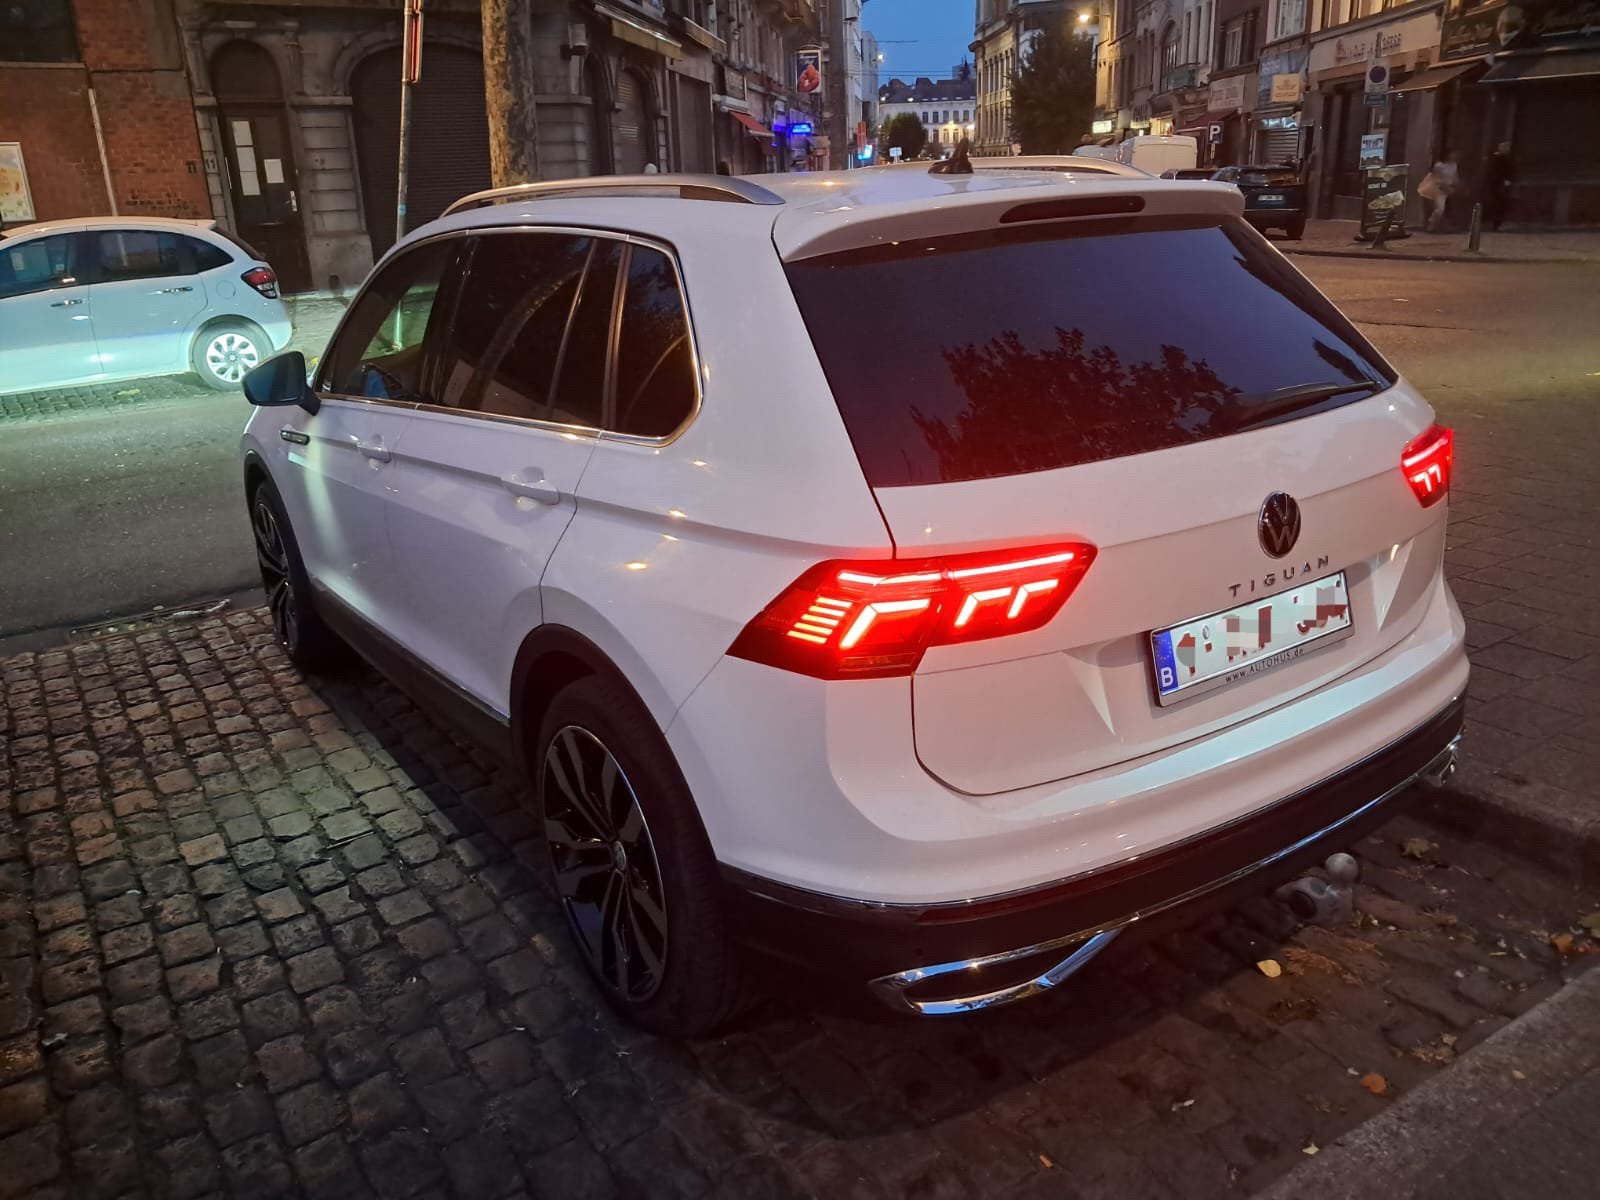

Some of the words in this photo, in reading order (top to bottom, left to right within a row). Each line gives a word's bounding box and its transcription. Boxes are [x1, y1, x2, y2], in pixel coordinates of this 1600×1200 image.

[1210, 125, 1221, 141] P
[1229, 555, 1329, 598] TIGUAN
[1161, 666, 1174, 688] B
[1225, 647, 1304, 683] www.AUTOHUS.de
